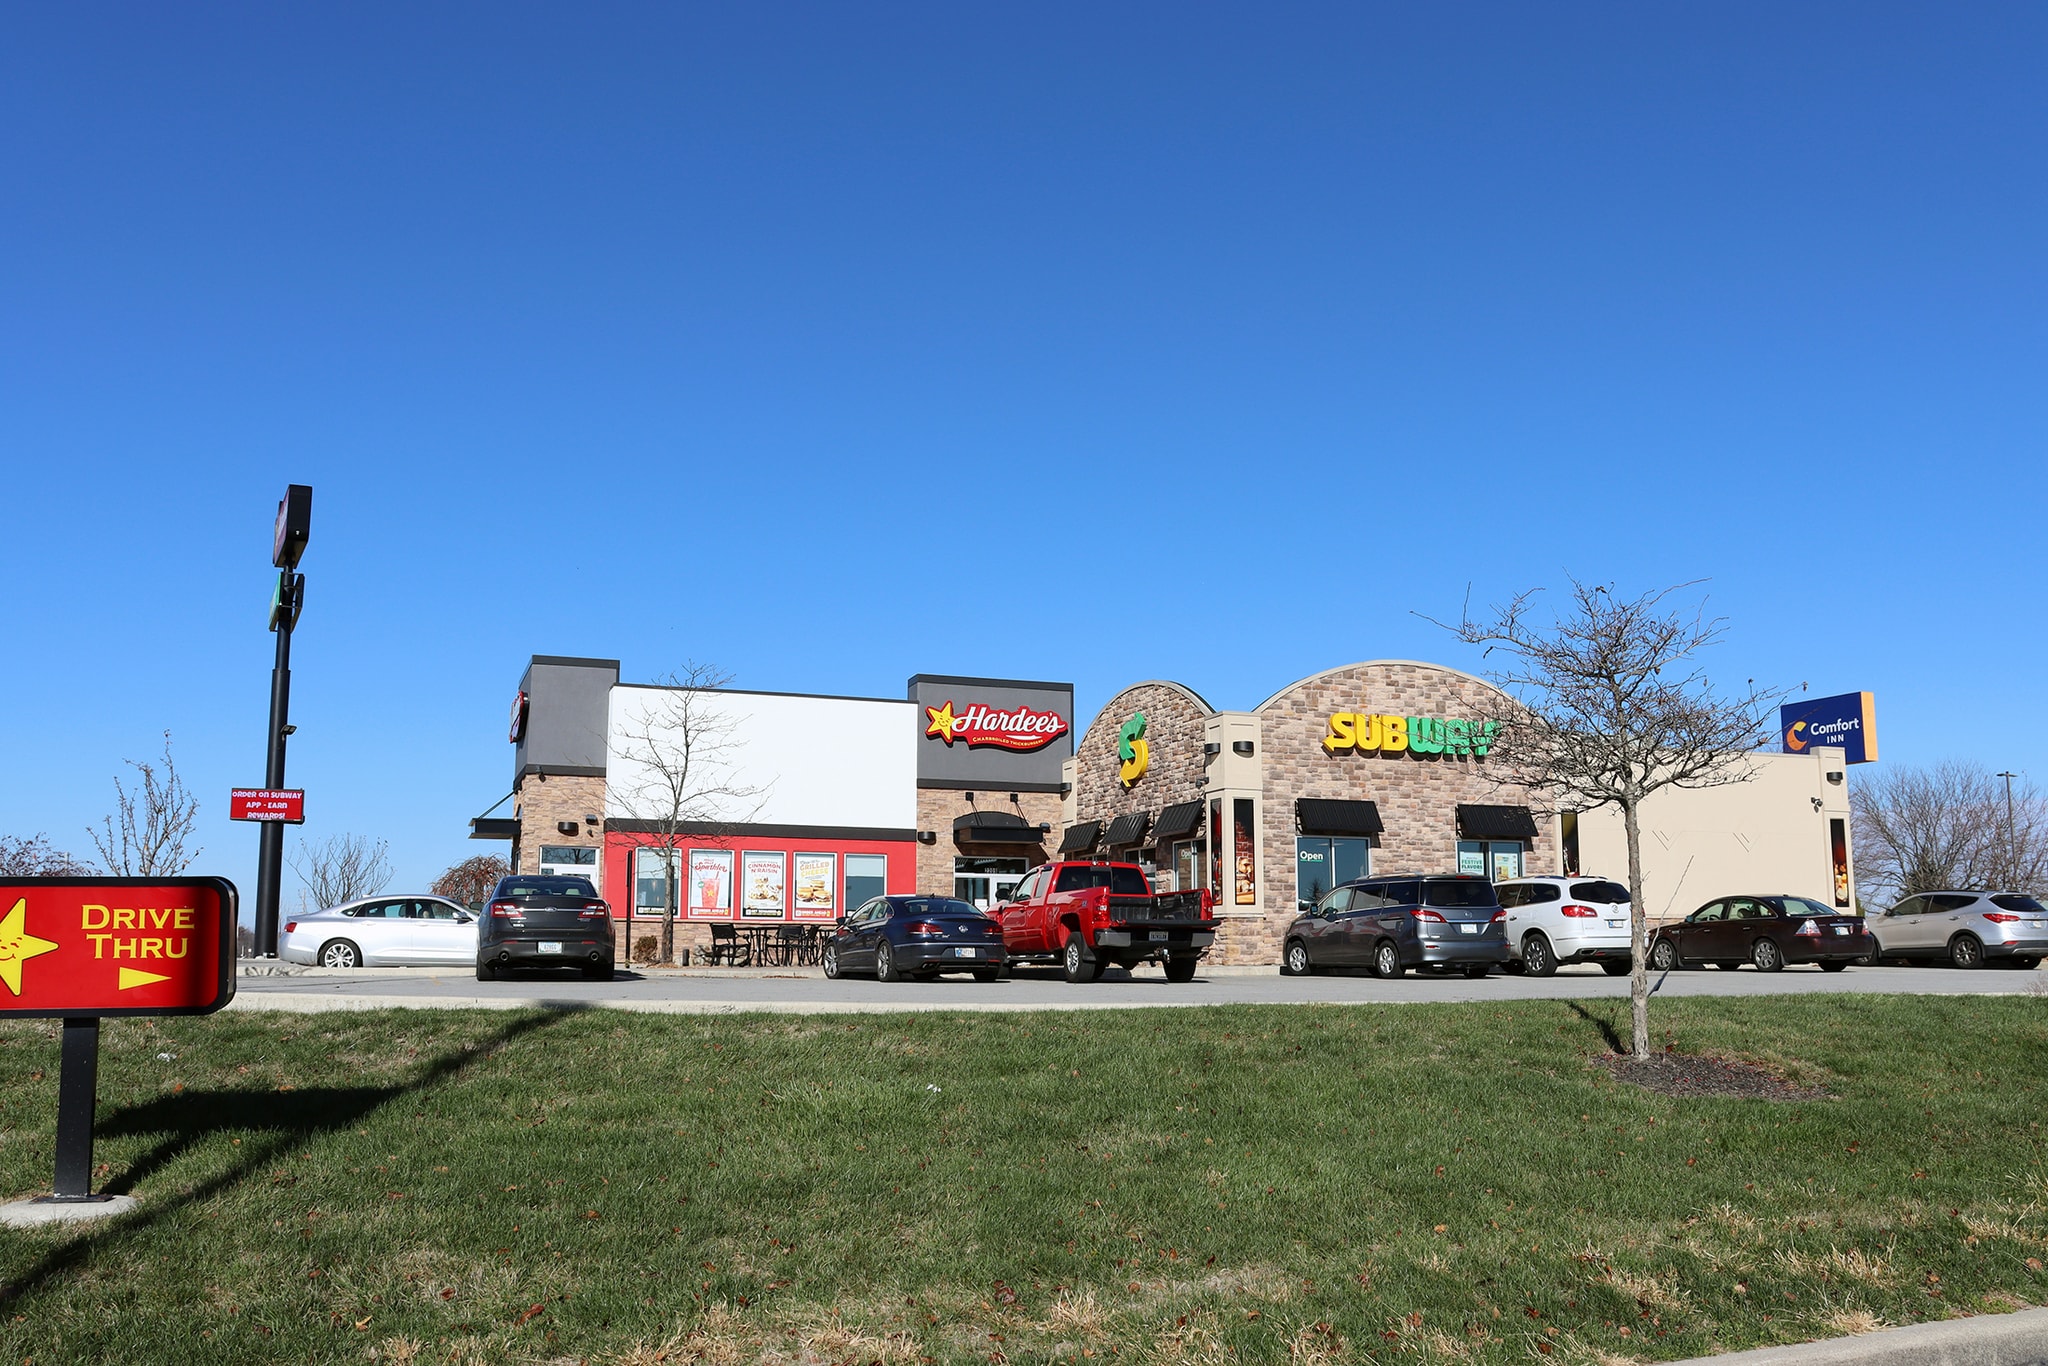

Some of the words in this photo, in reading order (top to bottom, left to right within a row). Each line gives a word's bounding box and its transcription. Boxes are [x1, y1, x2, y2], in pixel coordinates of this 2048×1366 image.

[951, 706, 1066, 733] Hardee's
[1810, 717, 1860, 736] Comfort
[1321, 711, 1501, 756] SUBWAY
[1826, 734, 1845, 744] INN
[800, 861, 830, 871] GRILLED
[1299, 850, 1324, 862] Open
[81, 904, 195, 930] DRIVE
[86, 933, 189, 959] THRU
